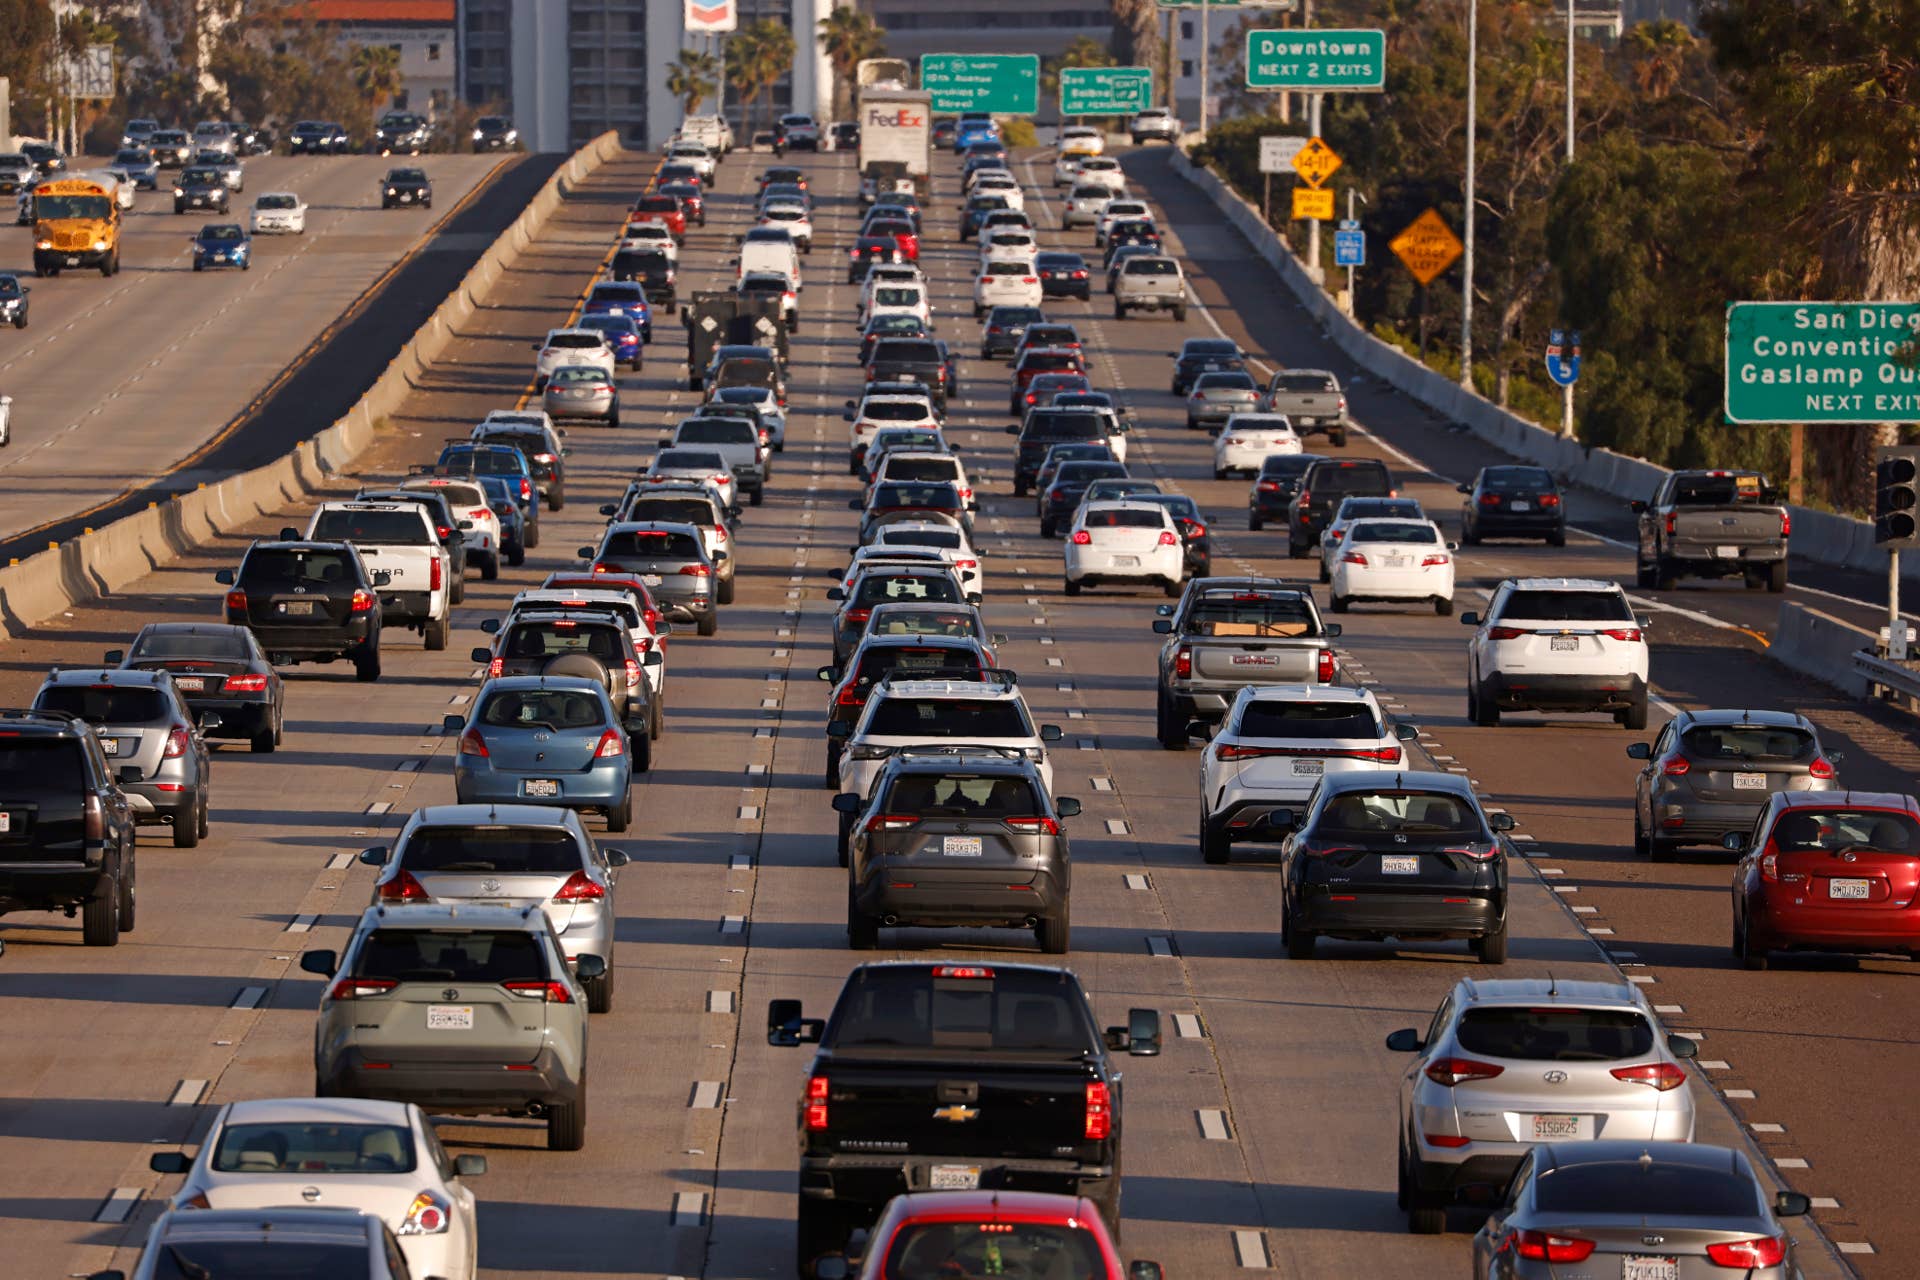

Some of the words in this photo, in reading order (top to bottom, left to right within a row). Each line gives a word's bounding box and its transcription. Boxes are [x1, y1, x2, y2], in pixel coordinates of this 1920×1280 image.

[1261, 40, 1371, 55] Downtown
[1258, 64, 1299, 76] NEXT
[1307, 62, 1319, 78] 2
[1326, 64, 1373, 76] EXITS
[869, 109, 922, 128] FedEx
[1794, 308, 1845, 329] San
[1741, 364, 1863, 388] Gaslamp
[1878, 363, 1920, 383] Qu
[1806, 395, 1863, 411] NEXT
[1233, 655, 1276, 665] GMC
